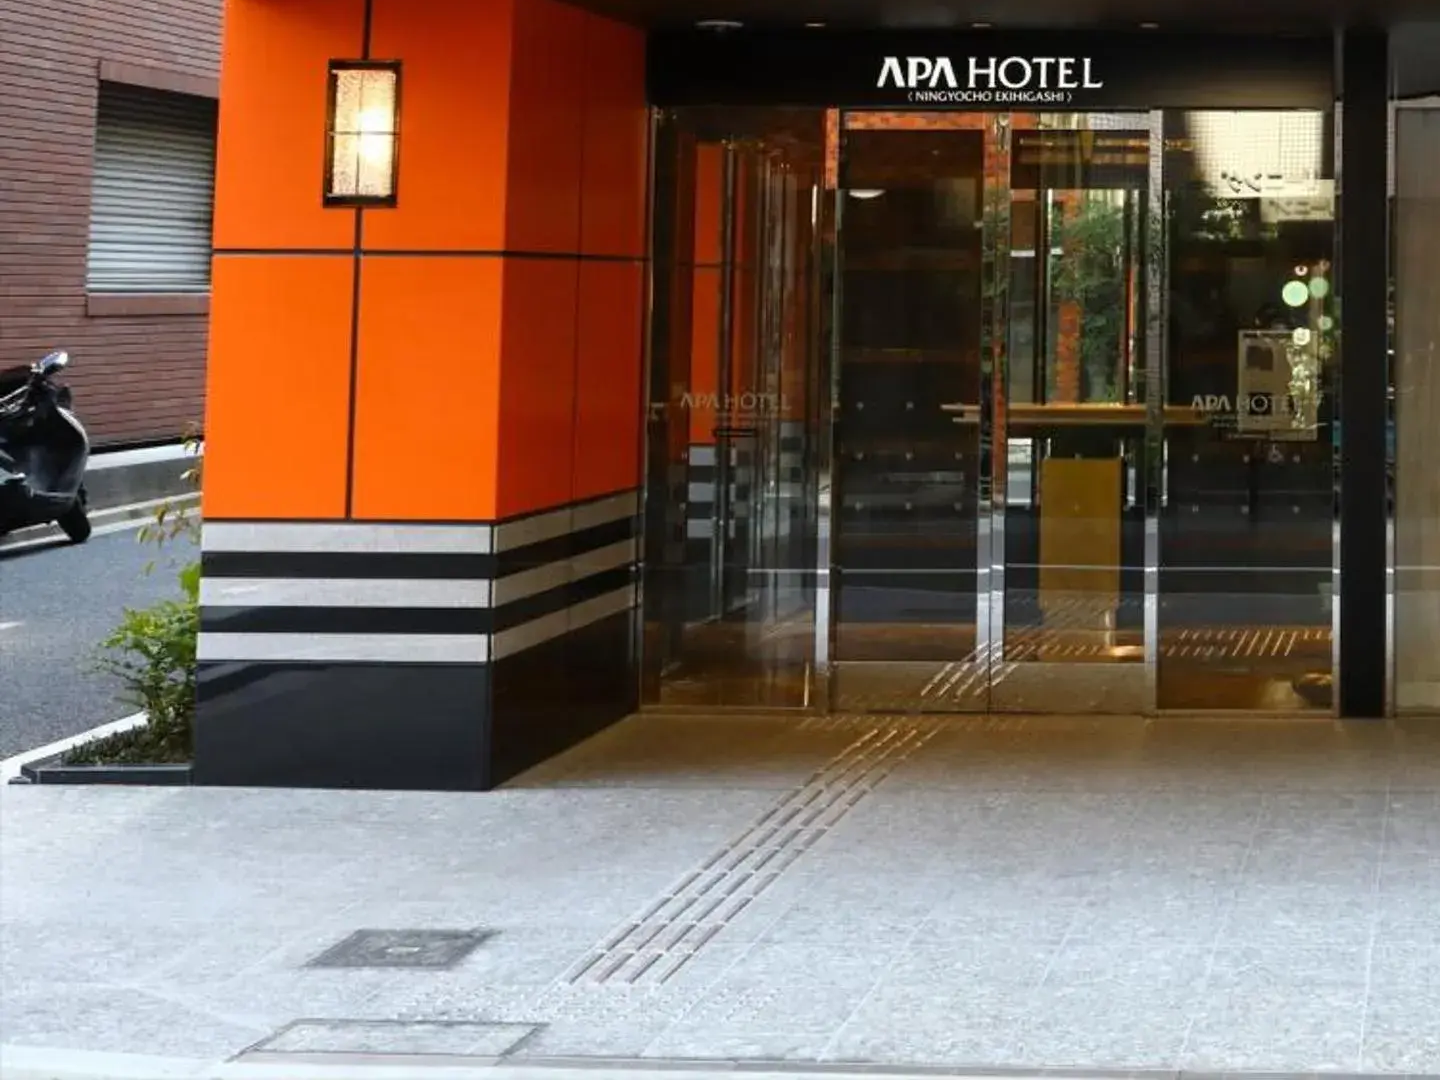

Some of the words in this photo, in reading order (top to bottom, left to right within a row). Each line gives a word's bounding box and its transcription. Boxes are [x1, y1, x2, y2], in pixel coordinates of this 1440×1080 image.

[875, 55, 958, 89] APA
[967, 55, 1105, 89] HOTEL
[915, 90, 993, 103] NINGYOCHO
[994, 90, 1065, 103] EKIHIGASHI
[680, 391, 720, 409] APA
[1191, 394, 1232, 412] APA
